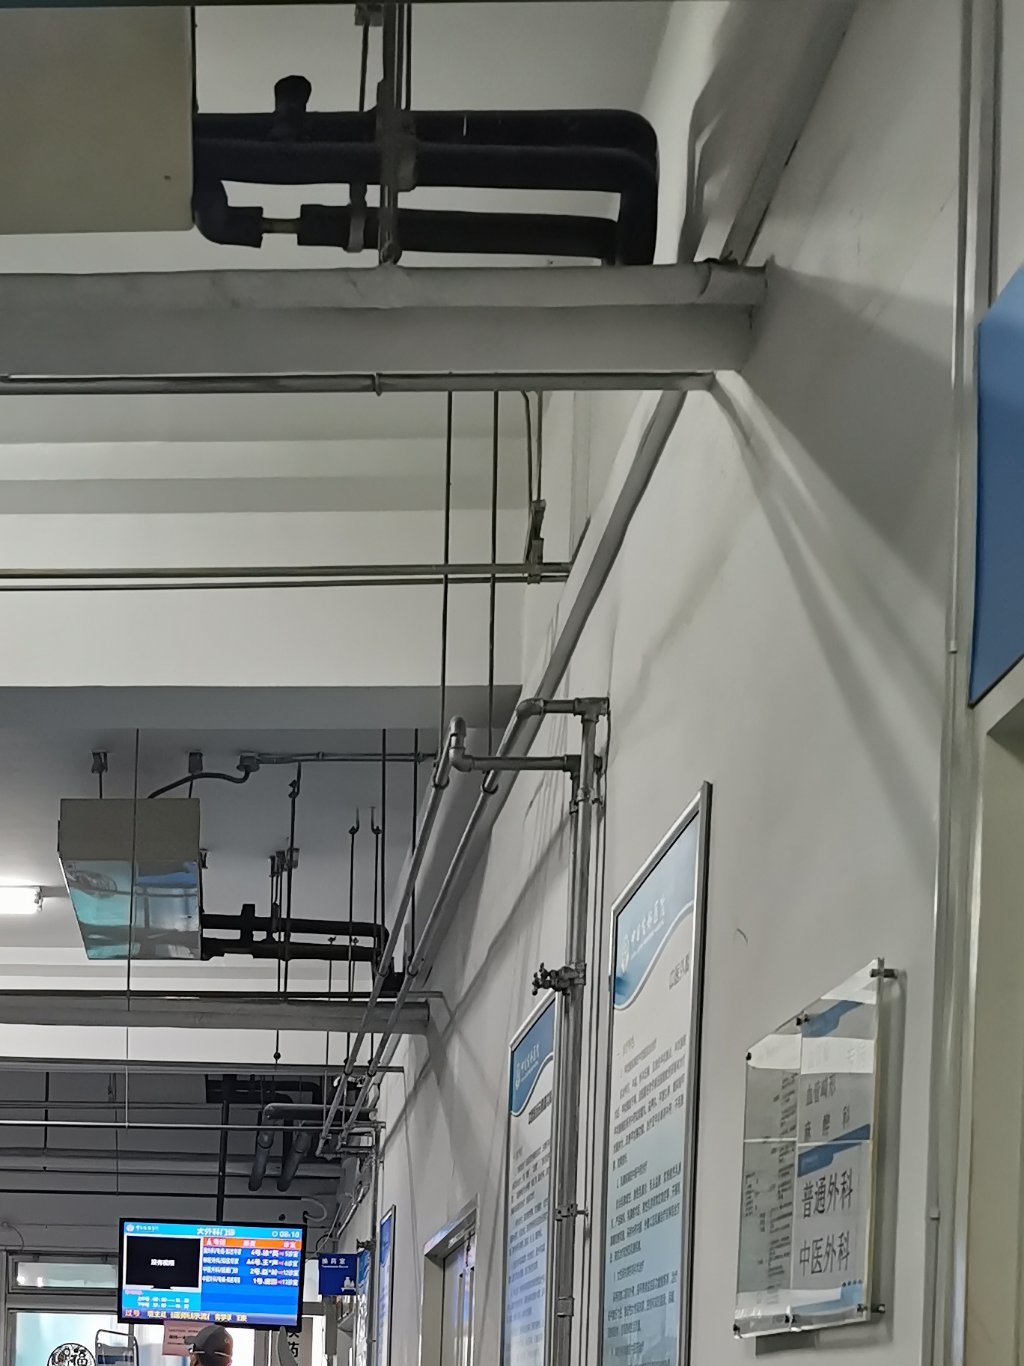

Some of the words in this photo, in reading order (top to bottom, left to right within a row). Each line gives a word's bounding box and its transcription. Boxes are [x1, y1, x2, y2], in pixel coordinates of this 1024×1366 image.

[802, 1168, 853, 1219] 普通外科
[800, 1230, 850, 1276] 中医外科
